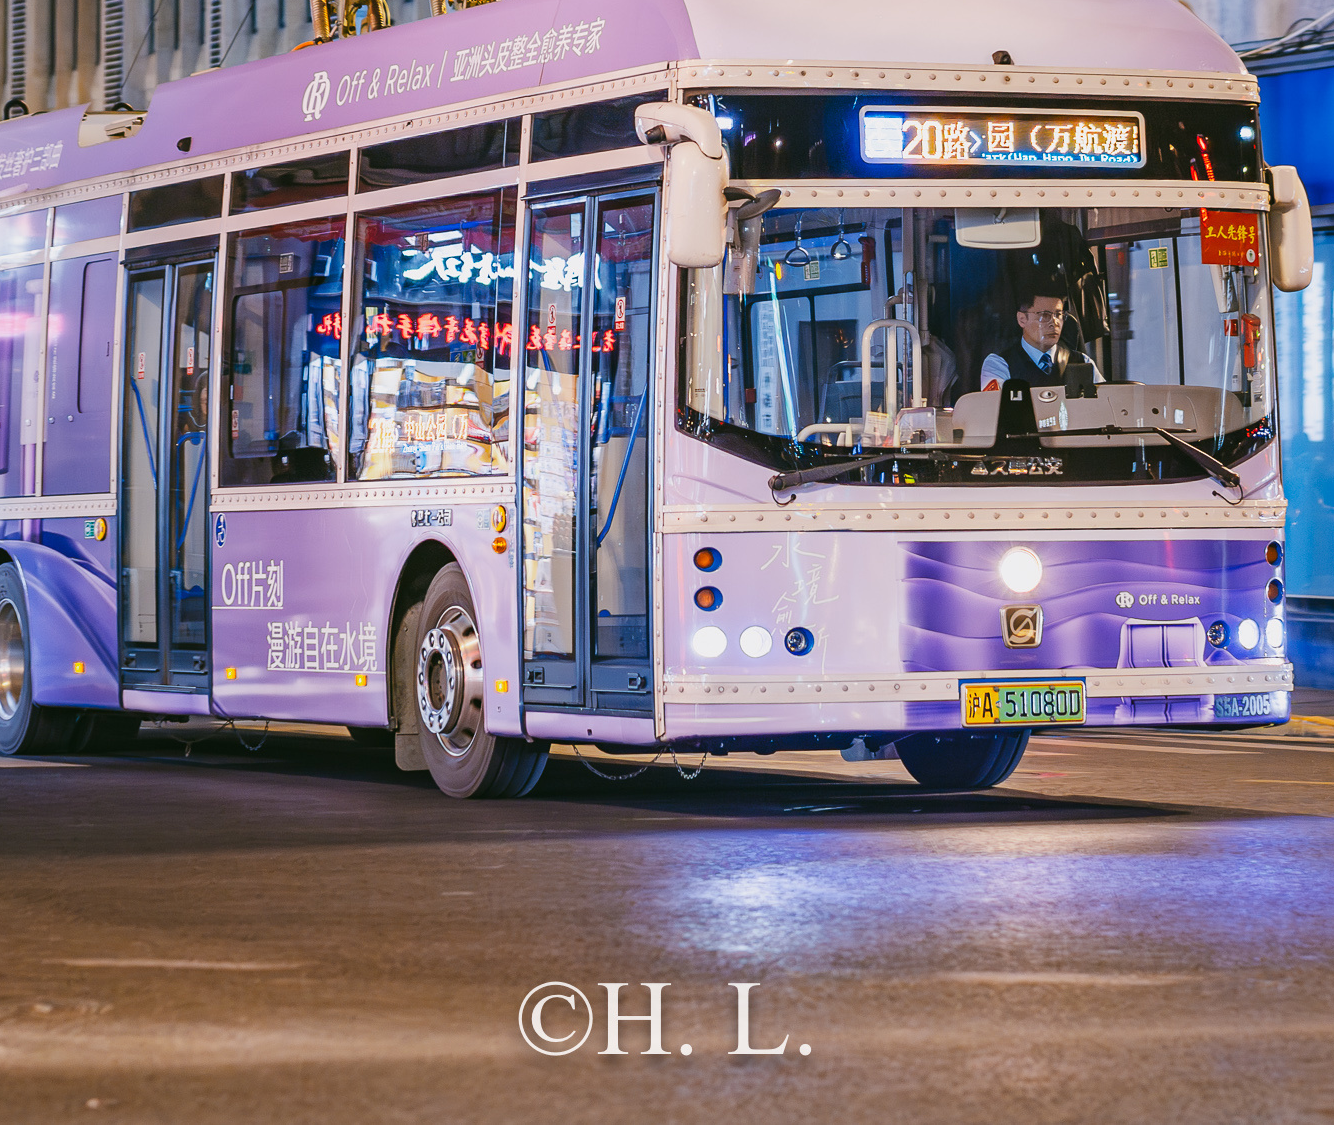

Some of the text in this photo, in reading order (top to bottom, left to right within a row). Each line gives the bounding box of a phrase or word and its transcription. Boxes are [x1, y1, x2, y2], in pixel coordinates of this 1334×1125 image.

[335, 69, 367, 106] Off
[367, 68, 381, 100] &
[384, 59, 436, 96] Relax
[450, 16, 606, 82] 亚洲头皮整全愈养专家
[1204, 224, 1256, 244] 工人先锋号
[221, 559, 284, 607] Off片刻
[1138, 594, 1157, 605] Off
[1160, 594, 1168, 605] &
[1171, 593, 1201, 605] Relax
[267, 620, 378, 672] 漫游自在水境
[968, 691, 994, 719] 沪A
